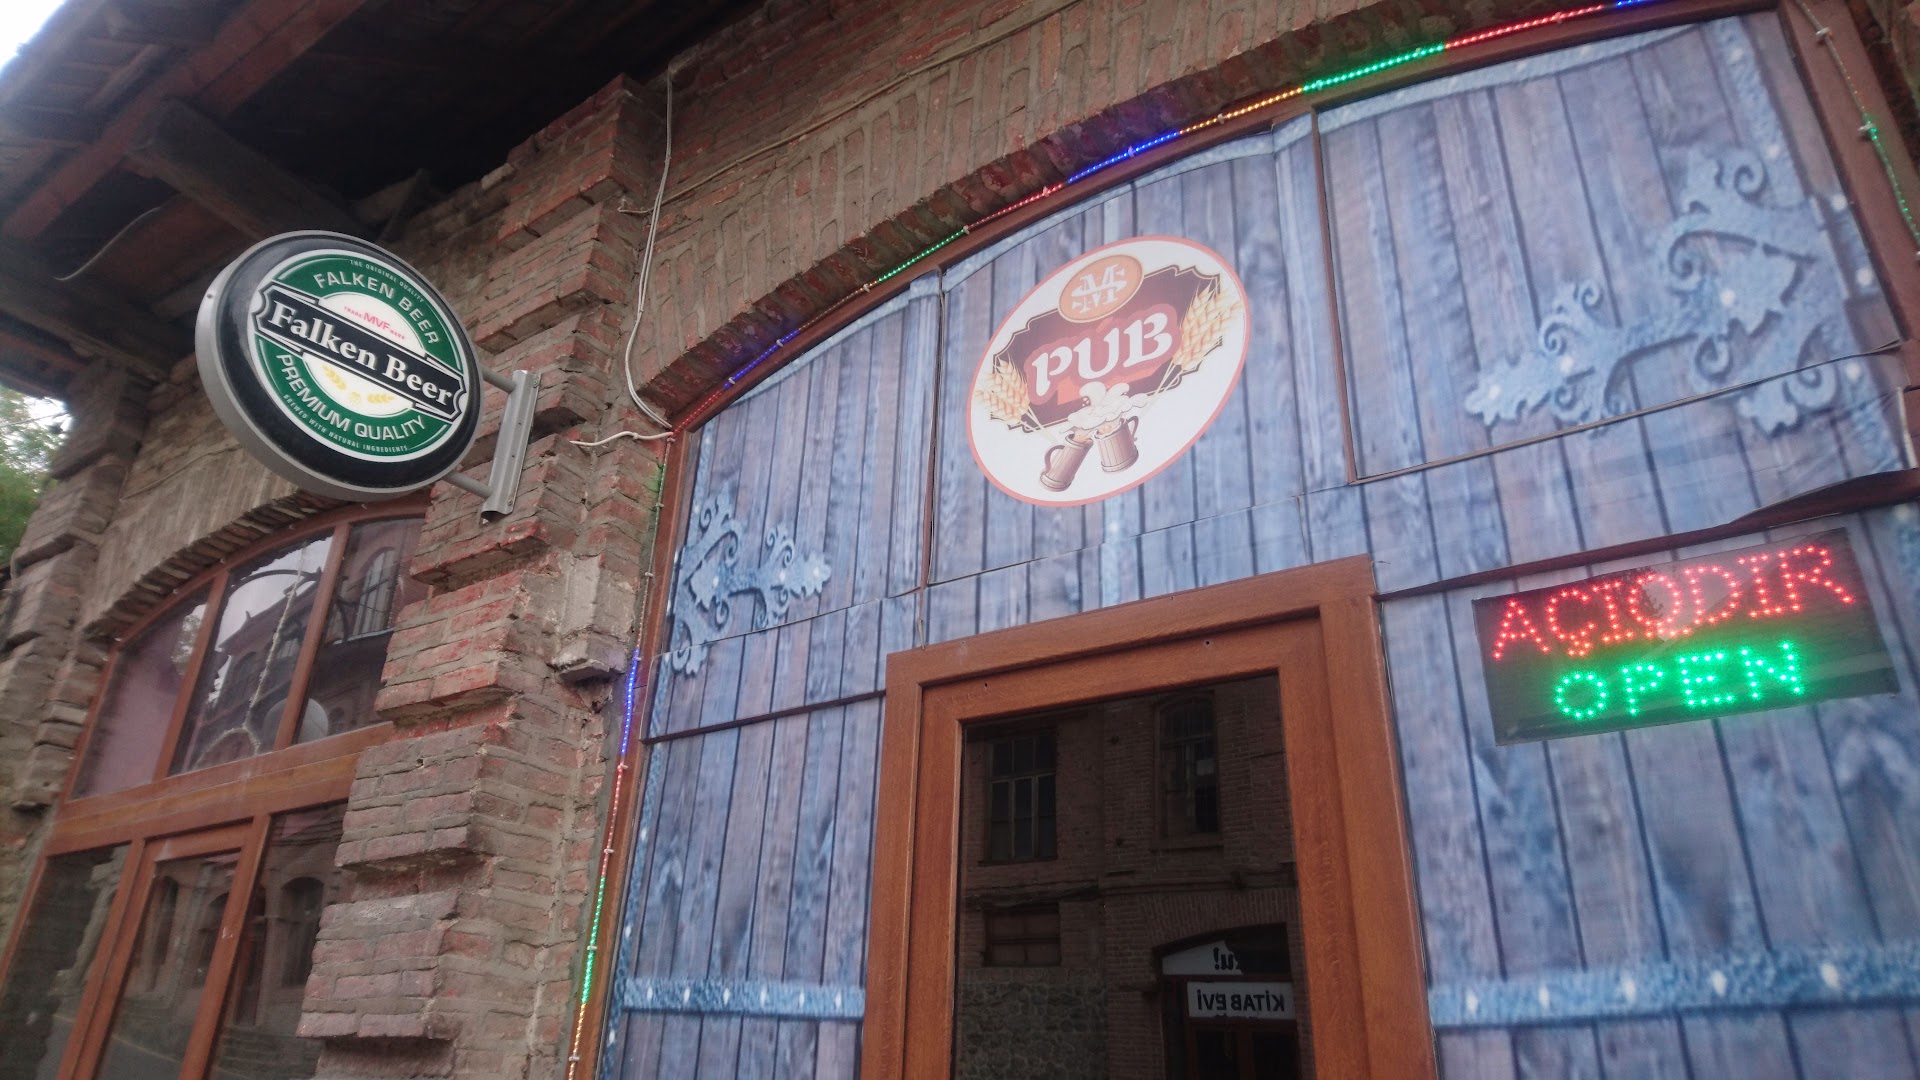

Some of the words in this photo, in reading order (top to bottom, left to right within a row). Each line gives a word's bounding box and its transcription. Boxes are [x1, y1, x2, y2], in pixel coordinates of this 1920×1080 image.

[313, 271, 395, 299] FALKEN
[398, 296, 440, 344] BEER
[363, 312, 391, 331] MVF
[365, 264, 398, 282] ORIGINAL
[399, 281, 425, 303] QUALITY
[267, 300, 378, 371] Falken
[382, 353, 453, 406] Beer
[1031, 312, 1173, 397] PUB
[276, 354, 351, 432] PREMIUM
[354, 414, 426, 441] QUALITY
[282, 394, 308, 419] BREWED
[308, 418, 327, 433] WITH
[328, 431, 360, 448] NATURAL
[362, 445, 408, 453] INGREDIENTS
[1553, 639, 1806, 720] OPEN
